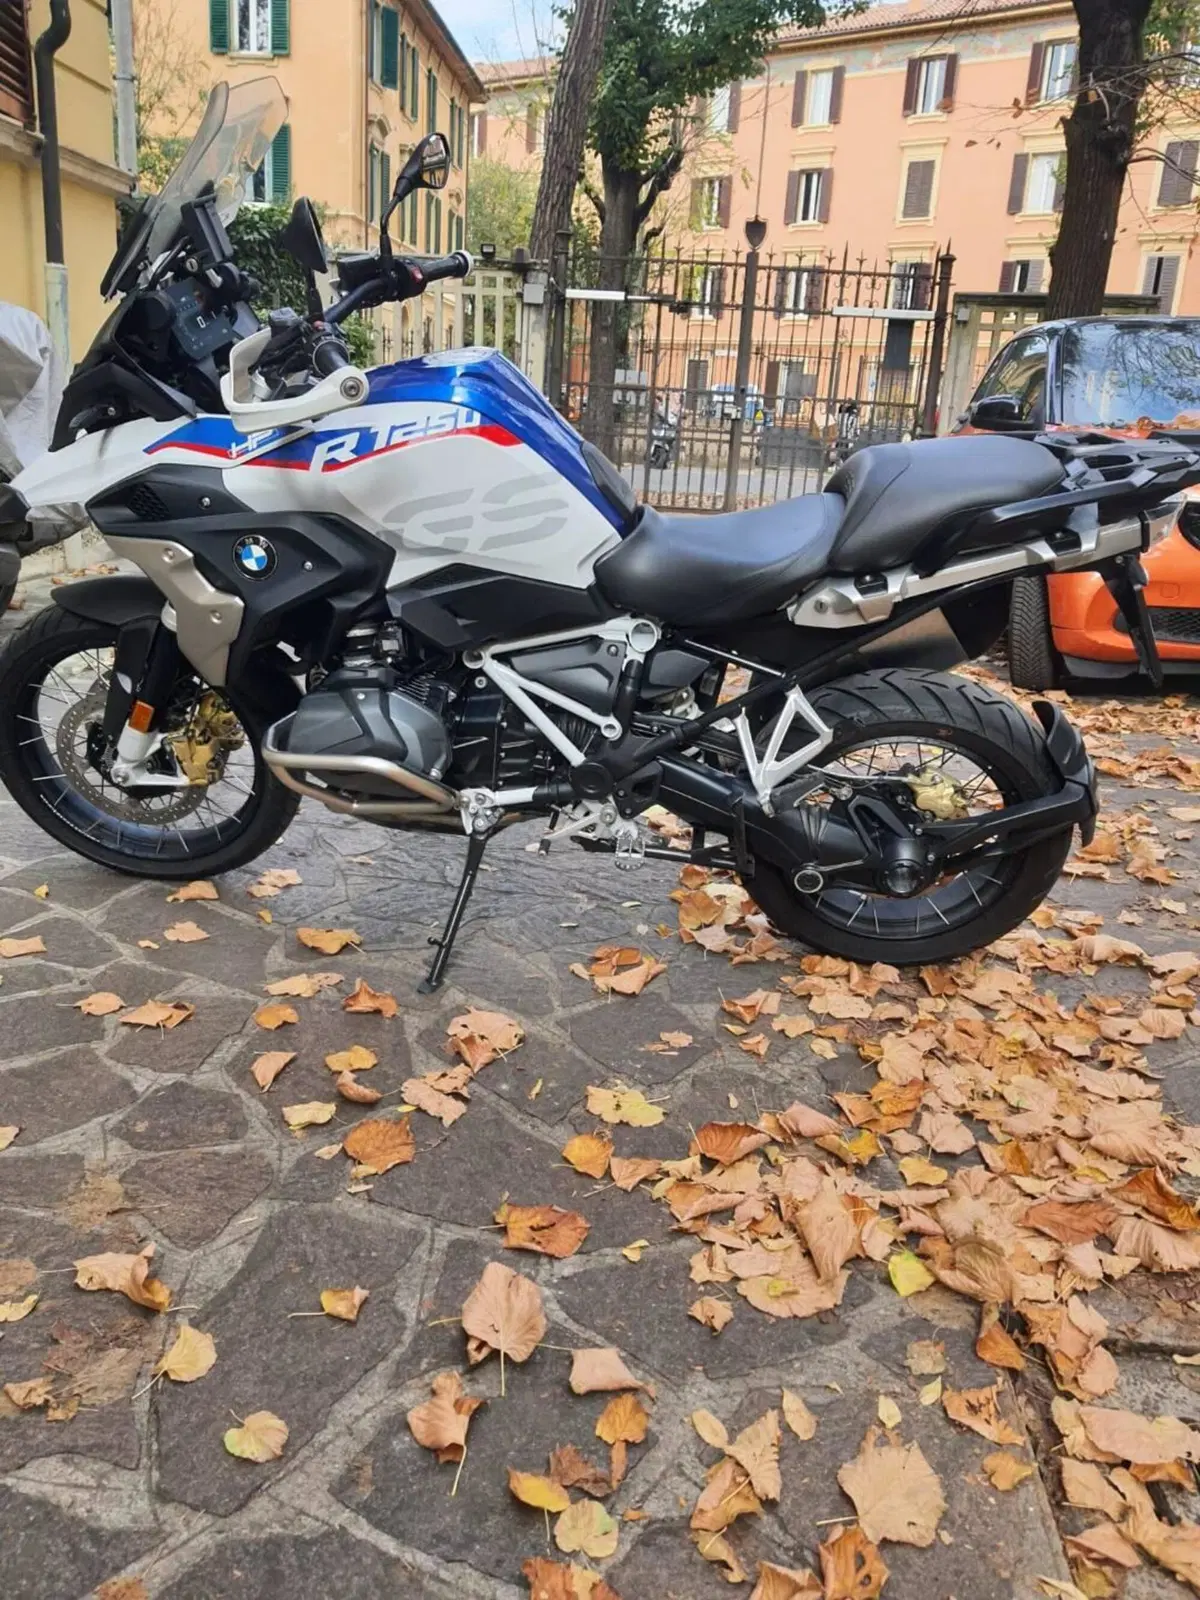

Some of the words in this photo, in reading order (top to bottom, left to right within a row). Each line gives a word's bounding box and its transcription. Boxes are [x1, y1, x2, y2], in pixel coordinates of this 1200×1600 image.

[309, 430, 360, 473] R
[370, 405, 482, 451] 1250
[236, 536, 269, 554] BMW
[378, 474, 569, 556] GS
